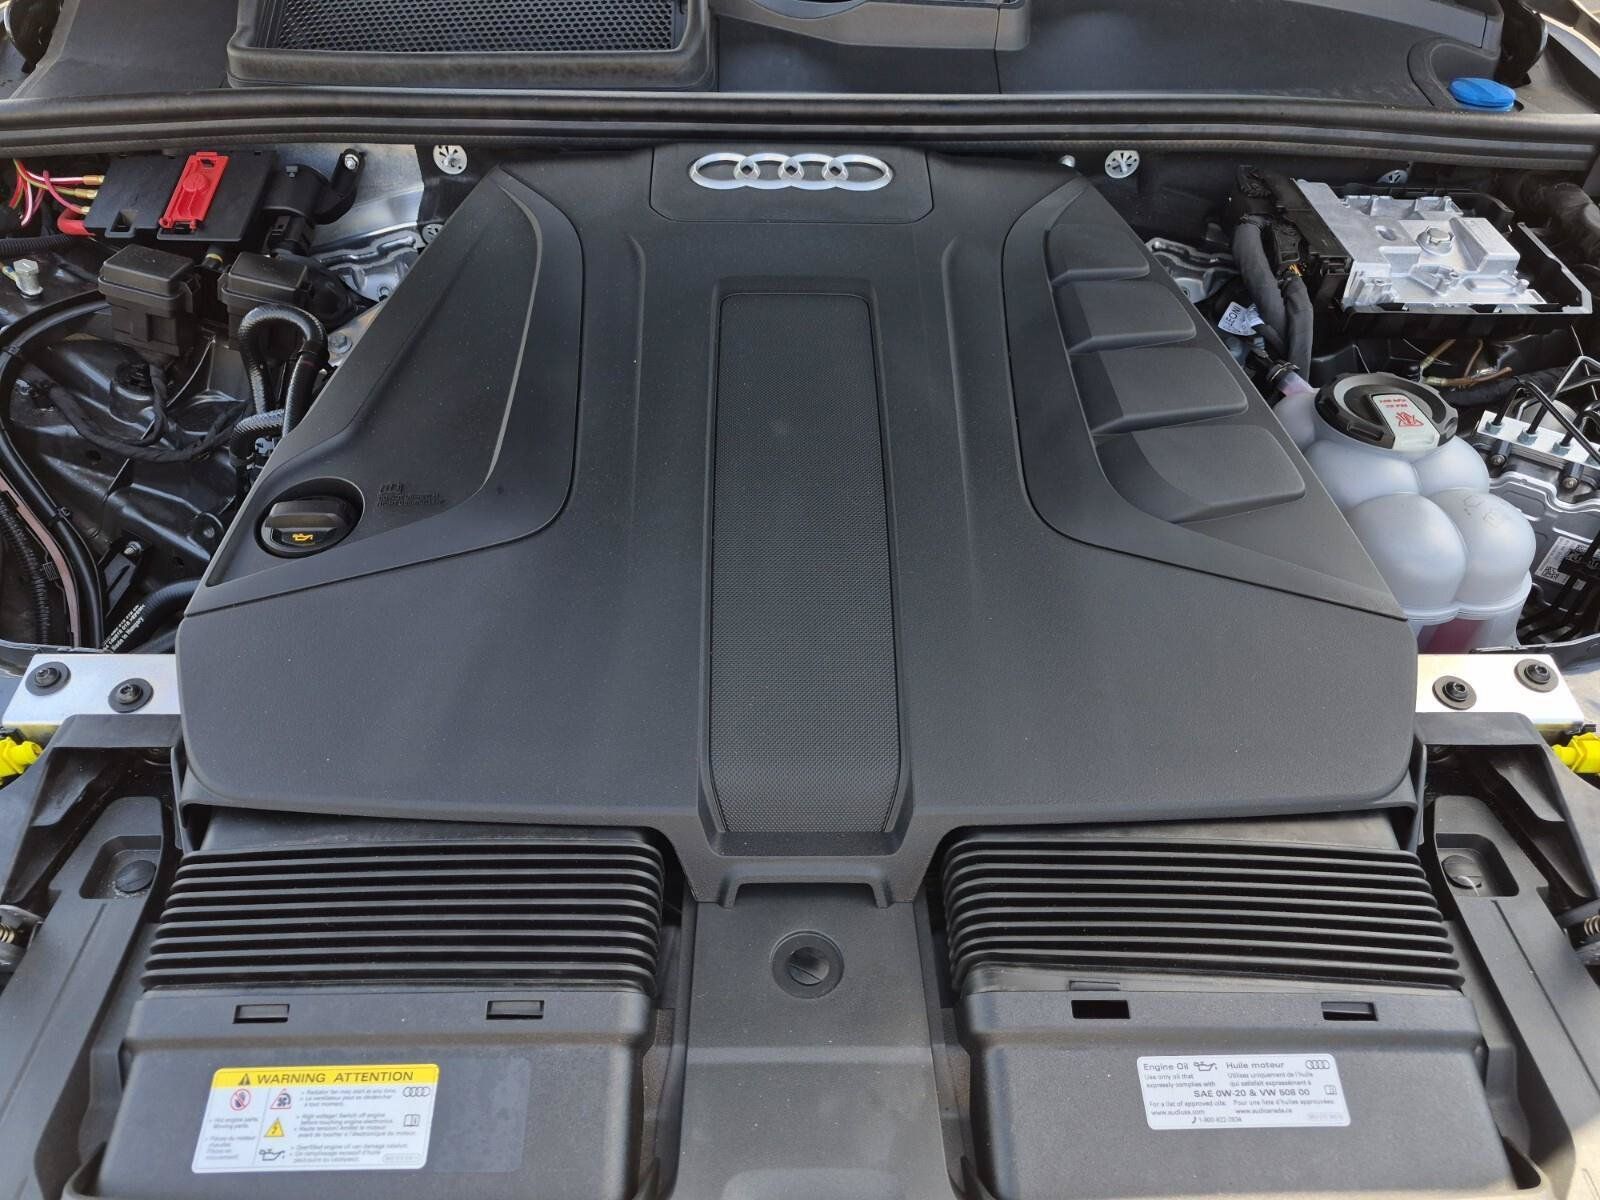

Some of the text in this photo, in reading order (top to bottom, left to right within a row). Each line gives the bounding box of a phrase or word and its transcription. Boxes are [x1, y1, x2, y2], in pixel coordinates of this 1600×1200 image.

[1143, 1062, 1189, 1072] Engine Oil
[1225, 1061, 1248, 1069] Huile
[256, 1071, 414, 1084] WARNING ATTENTION
[1193, 1088, 1311, 1098] SAE 0W-20 & VW 508 00
